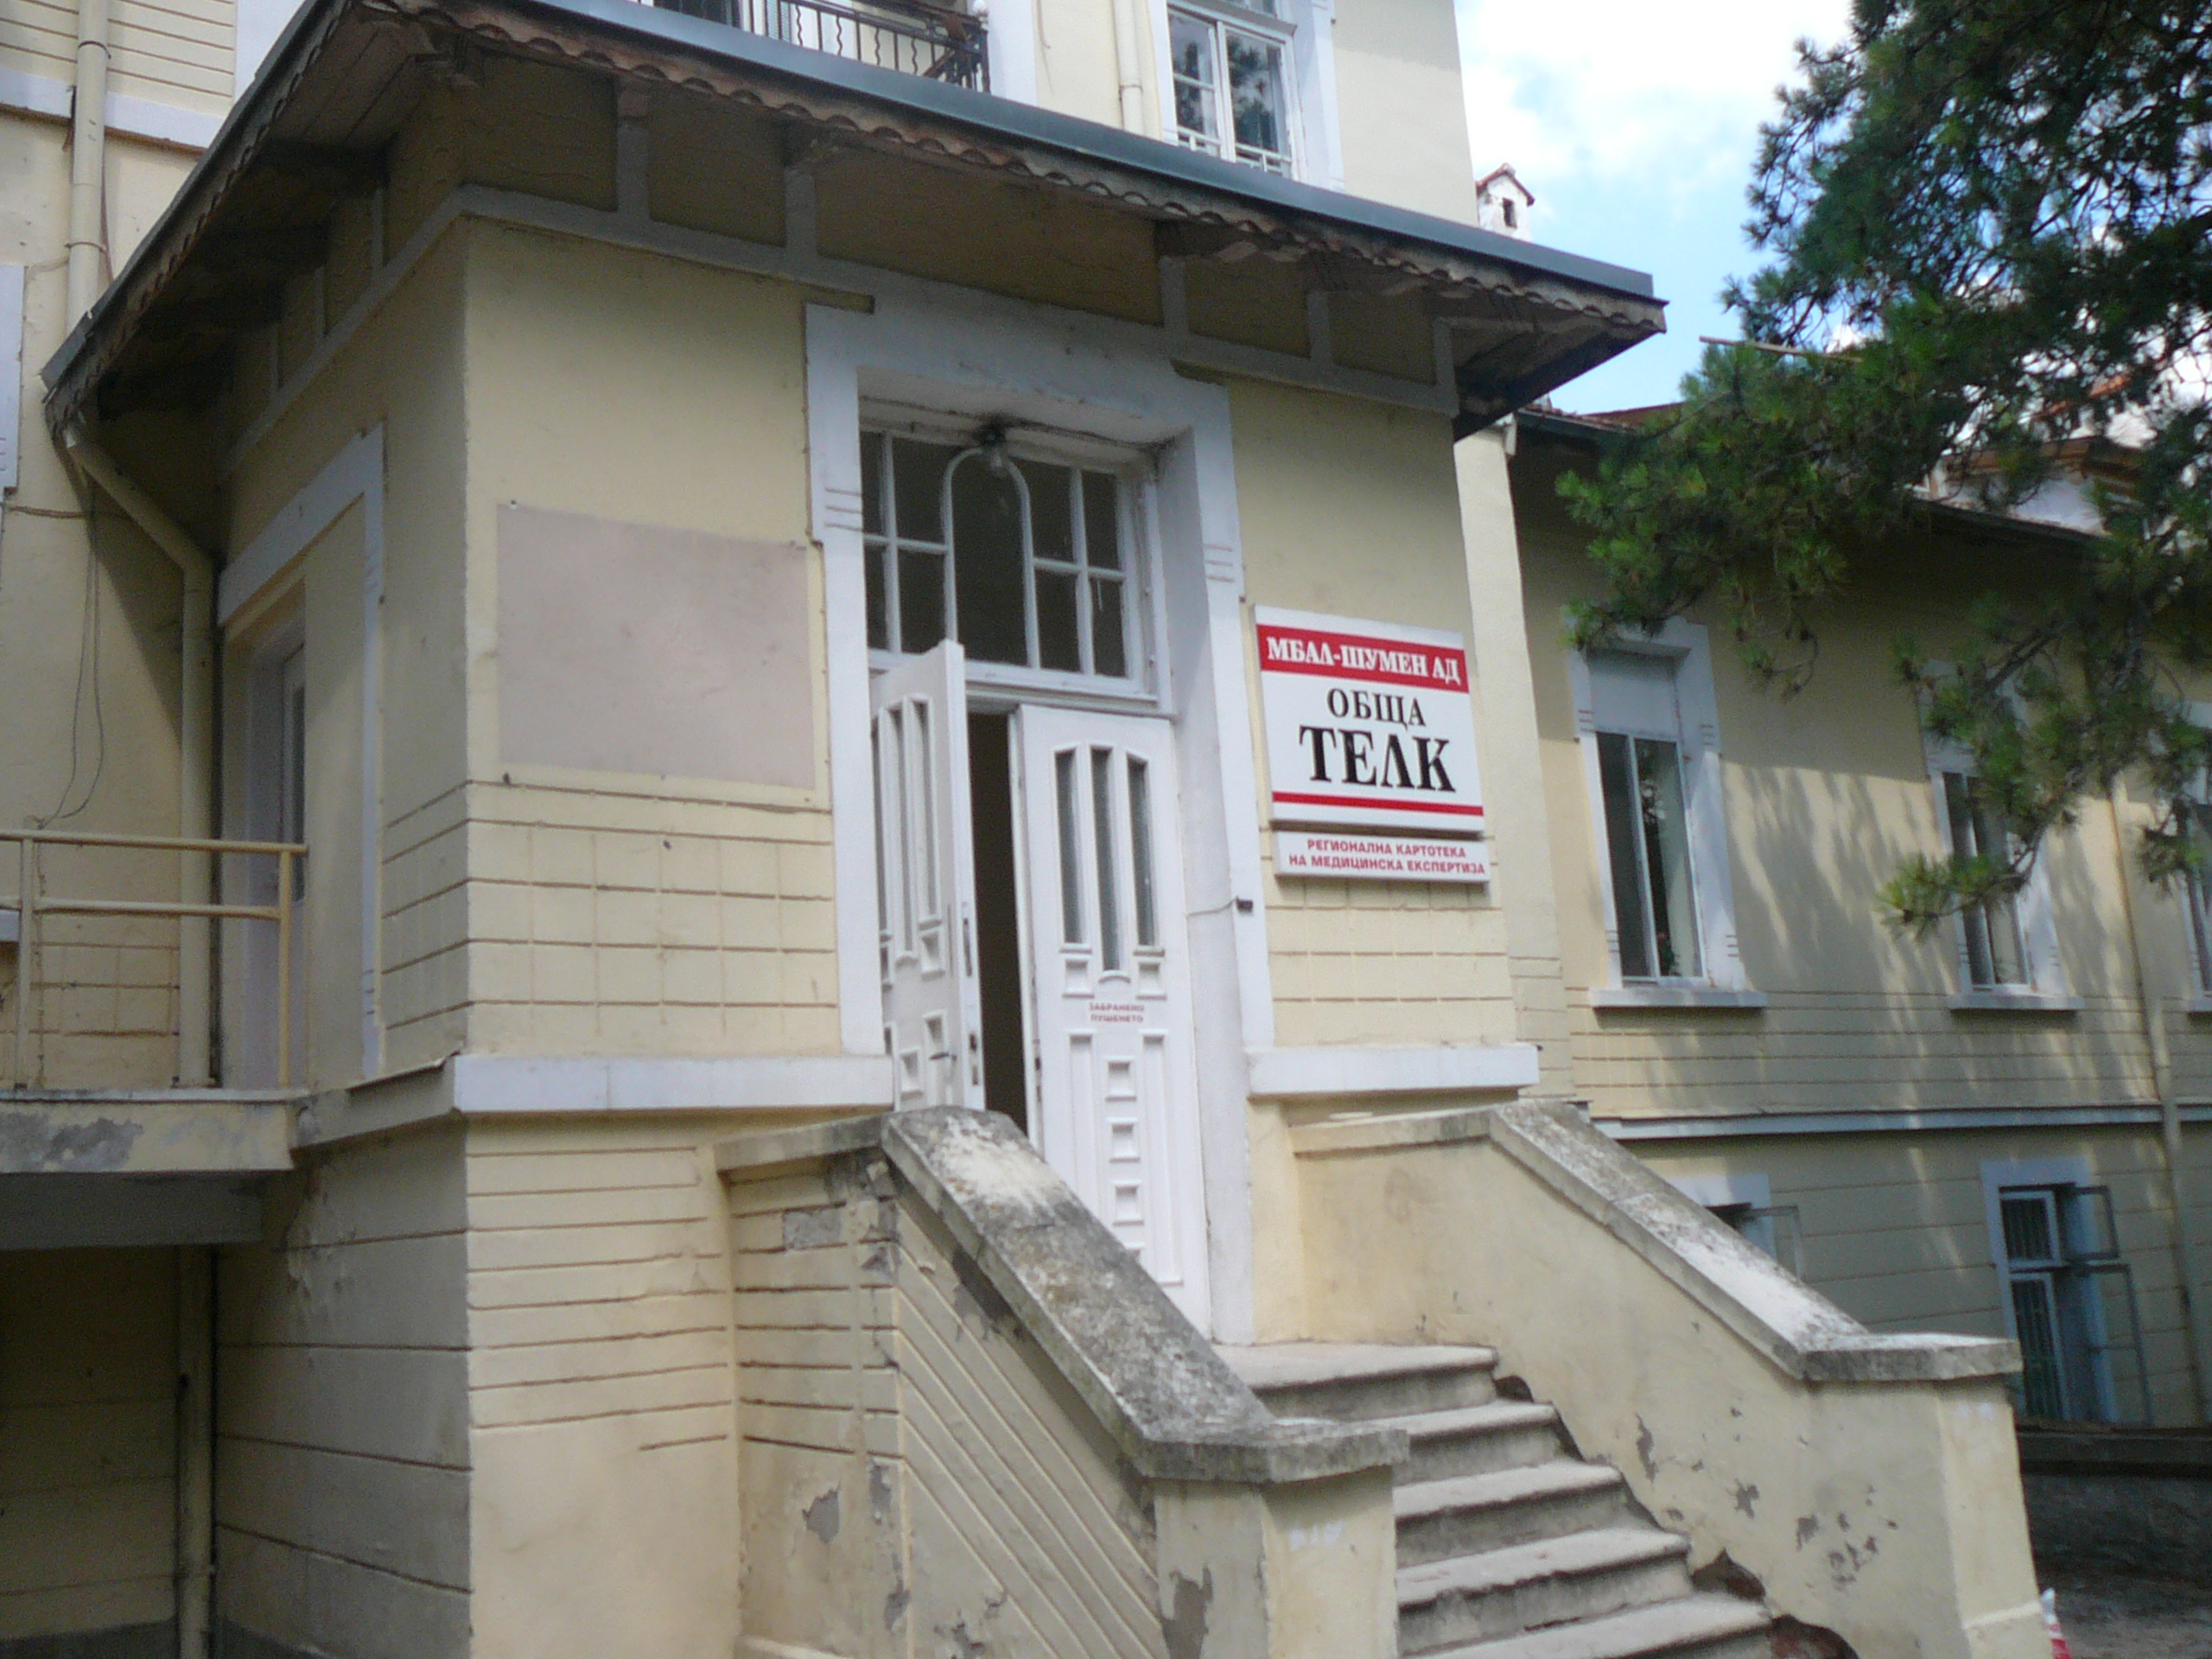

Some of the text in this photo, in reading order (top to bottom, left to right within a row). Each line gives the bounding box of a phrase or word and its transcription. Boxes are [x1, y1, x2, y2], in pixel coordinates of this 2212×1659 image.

[1266, 637, 1461, 686] МБАЛ-ШУМЕН АД
[1326, 688, 1427, 730] ОБЩА
[1299, 725, 1456, 793] ТЕЛК
[1288, 854, 1485, 874] НА МЕДИЦИНСКА ЕКСПЕРТИЗА
[1306, 838, 1466, 858] РЕГИОНАЛНА КАРТОТЕКА
